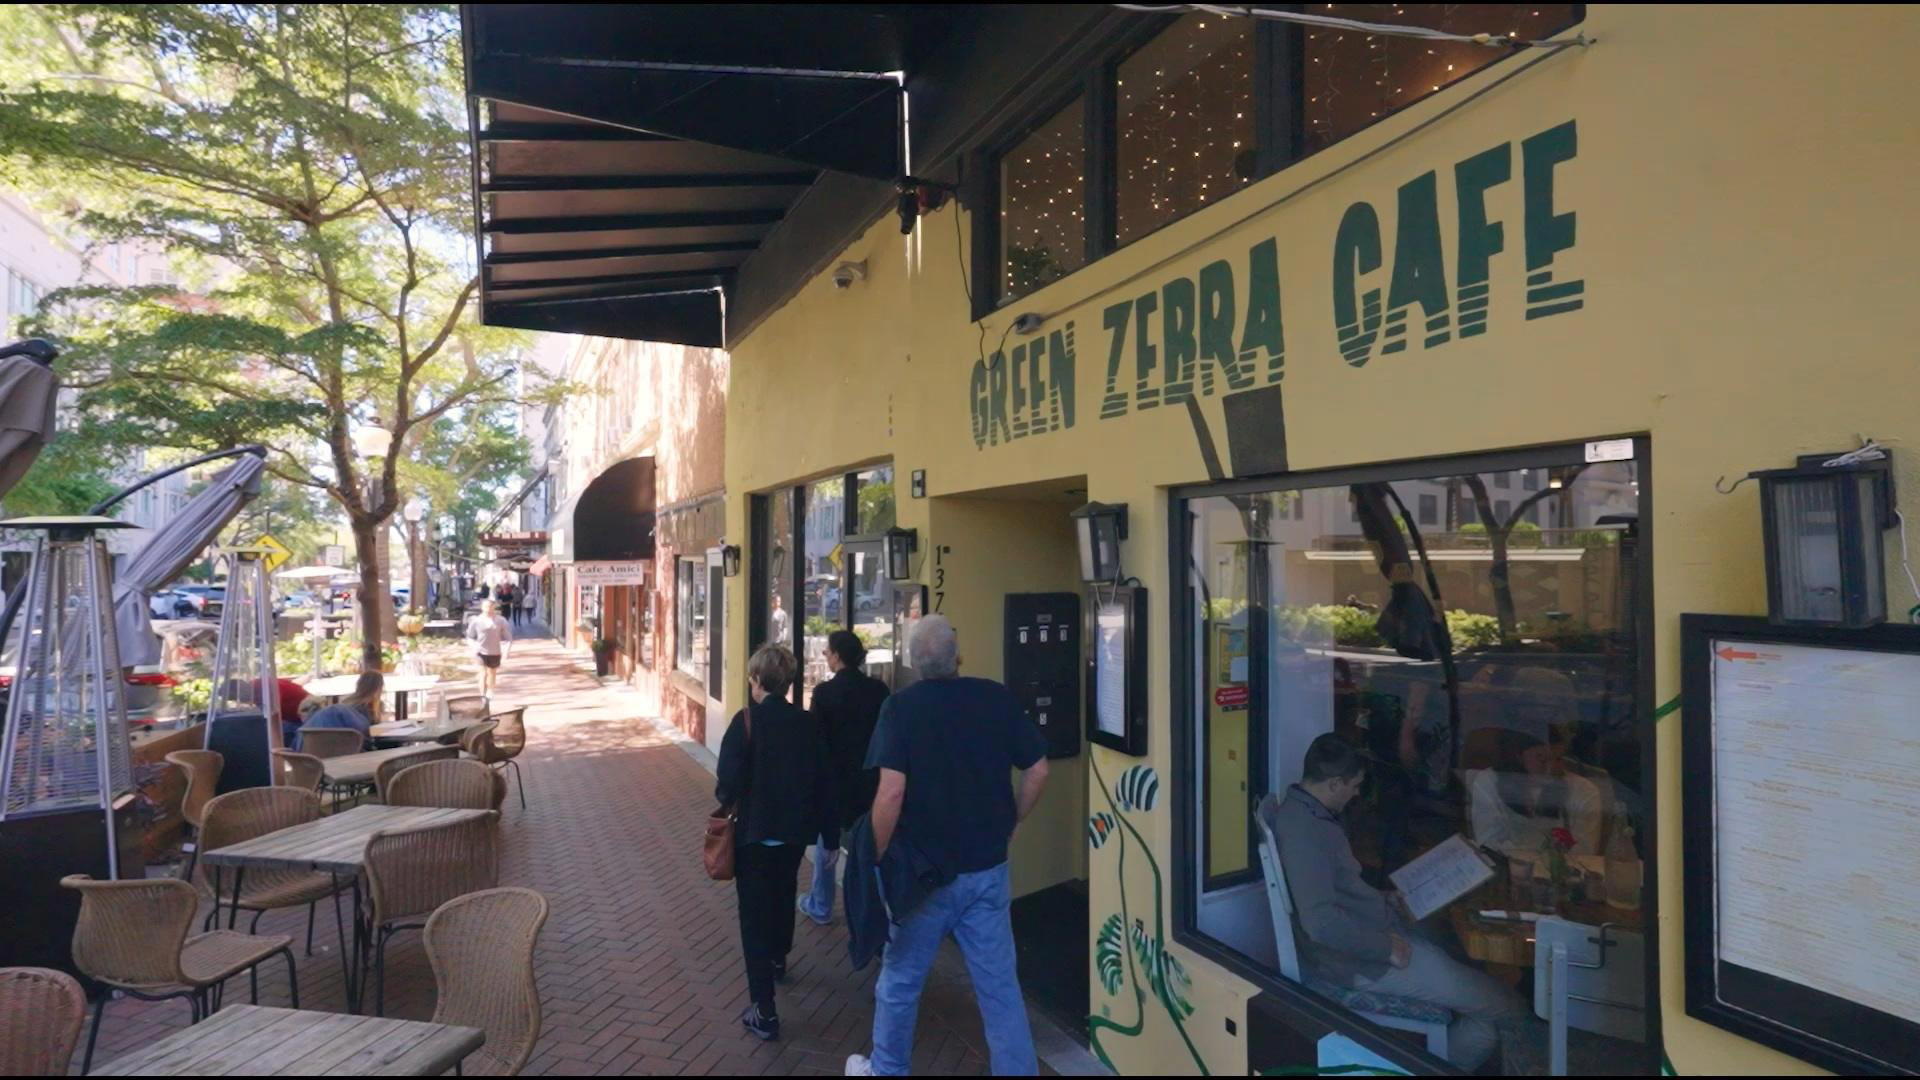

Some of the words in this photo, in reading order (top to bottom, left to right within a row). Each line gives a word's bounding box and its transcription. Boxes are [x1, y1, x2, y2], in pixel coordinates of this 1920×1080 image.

[971, 320, 1076, 451] GREEN
[1100, 236, 1285, 419] ZEBRA
[1333, 119, 1585, 368] CAFE
[577, 565, 604, 573] Cafe
[609, 565, 640, 573] Amici
[935, 545, 945, 616] 137
